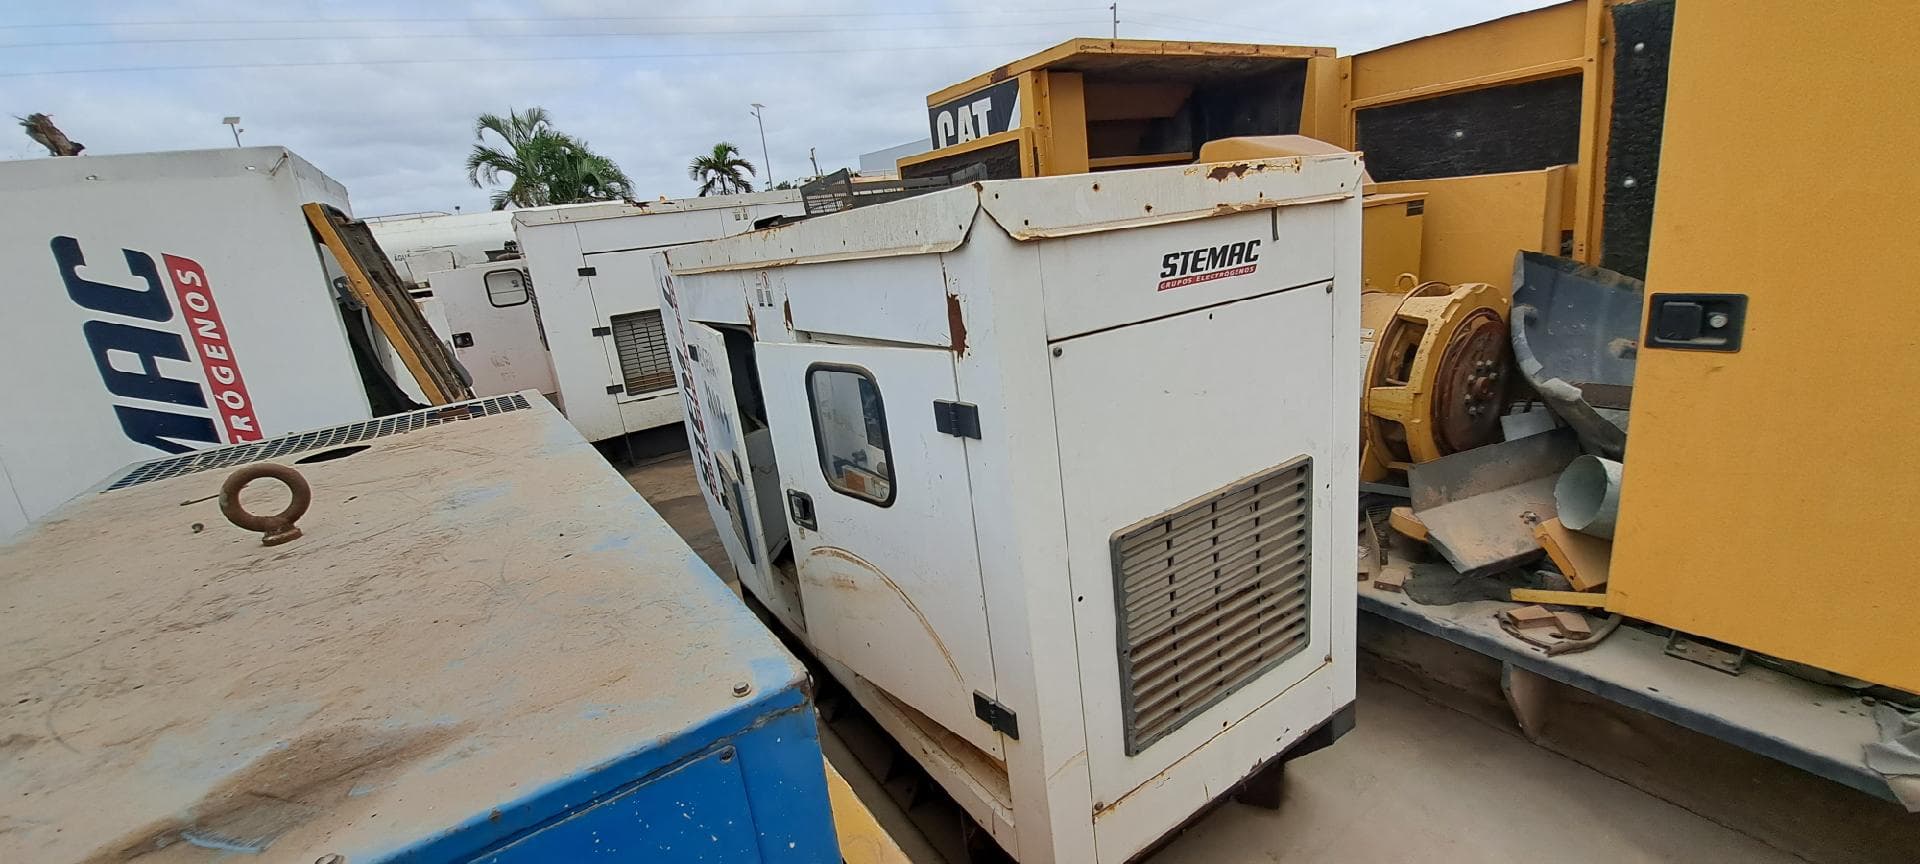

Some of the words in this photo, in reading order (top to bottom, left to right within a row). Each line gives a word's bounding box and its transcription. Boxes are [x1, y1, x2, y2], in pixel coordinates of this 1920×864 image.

[936, 96, 992, 149] CAT
[1160, 240, 1261, 278] STEMAC
[1160, 277, 1192, 289] GRUPOS
